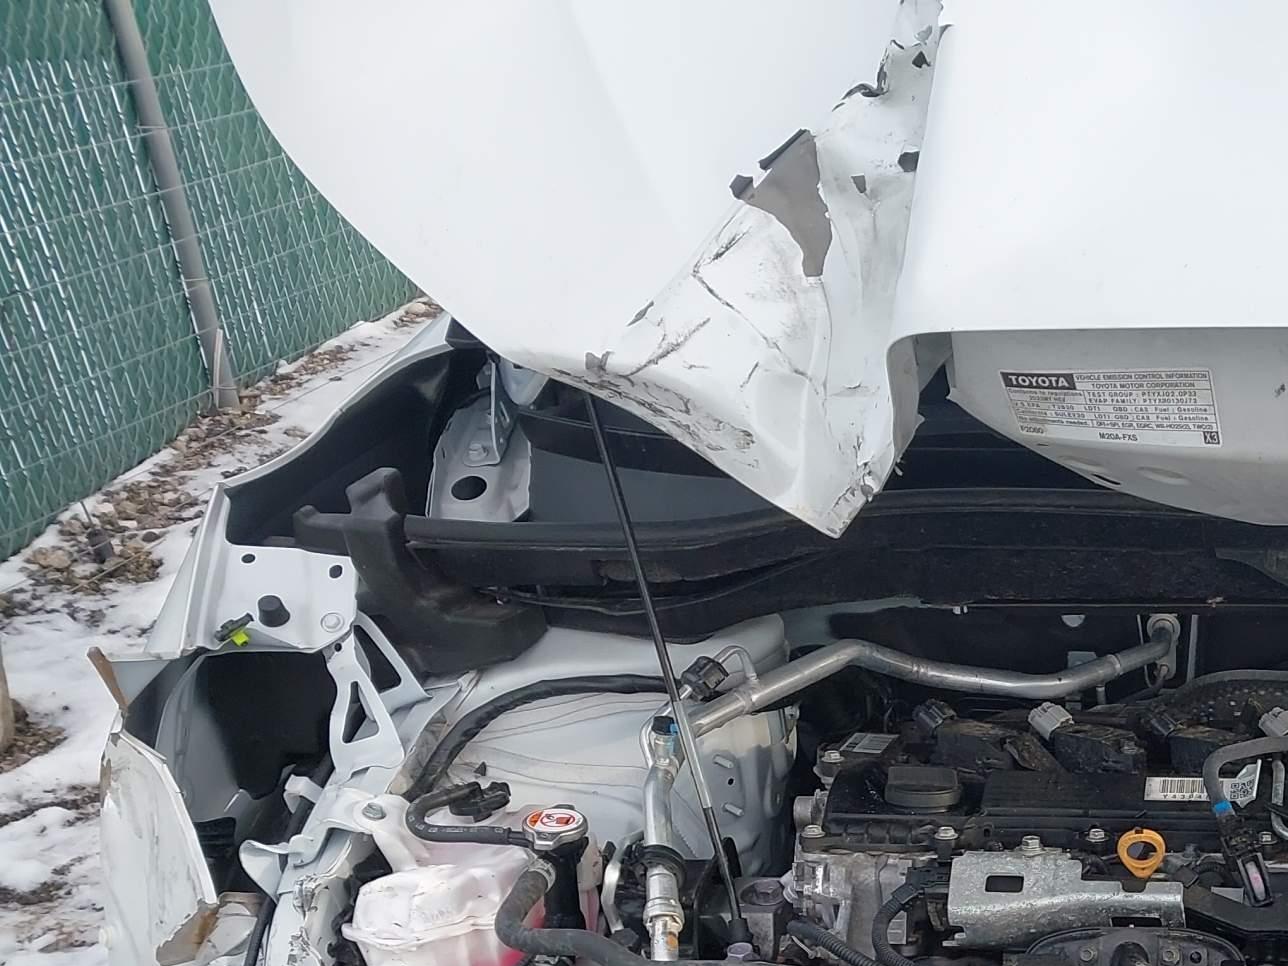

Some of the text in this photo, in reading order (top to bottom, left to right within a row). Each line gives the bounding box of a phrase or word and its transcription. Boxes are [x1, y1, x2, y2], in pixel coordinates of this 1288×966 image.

[1008, 375, 1069, 387] TOYOTA
[1099, 431, 1138, 442] M20A-FXS
[1204, 432, 1218, 443] X3
